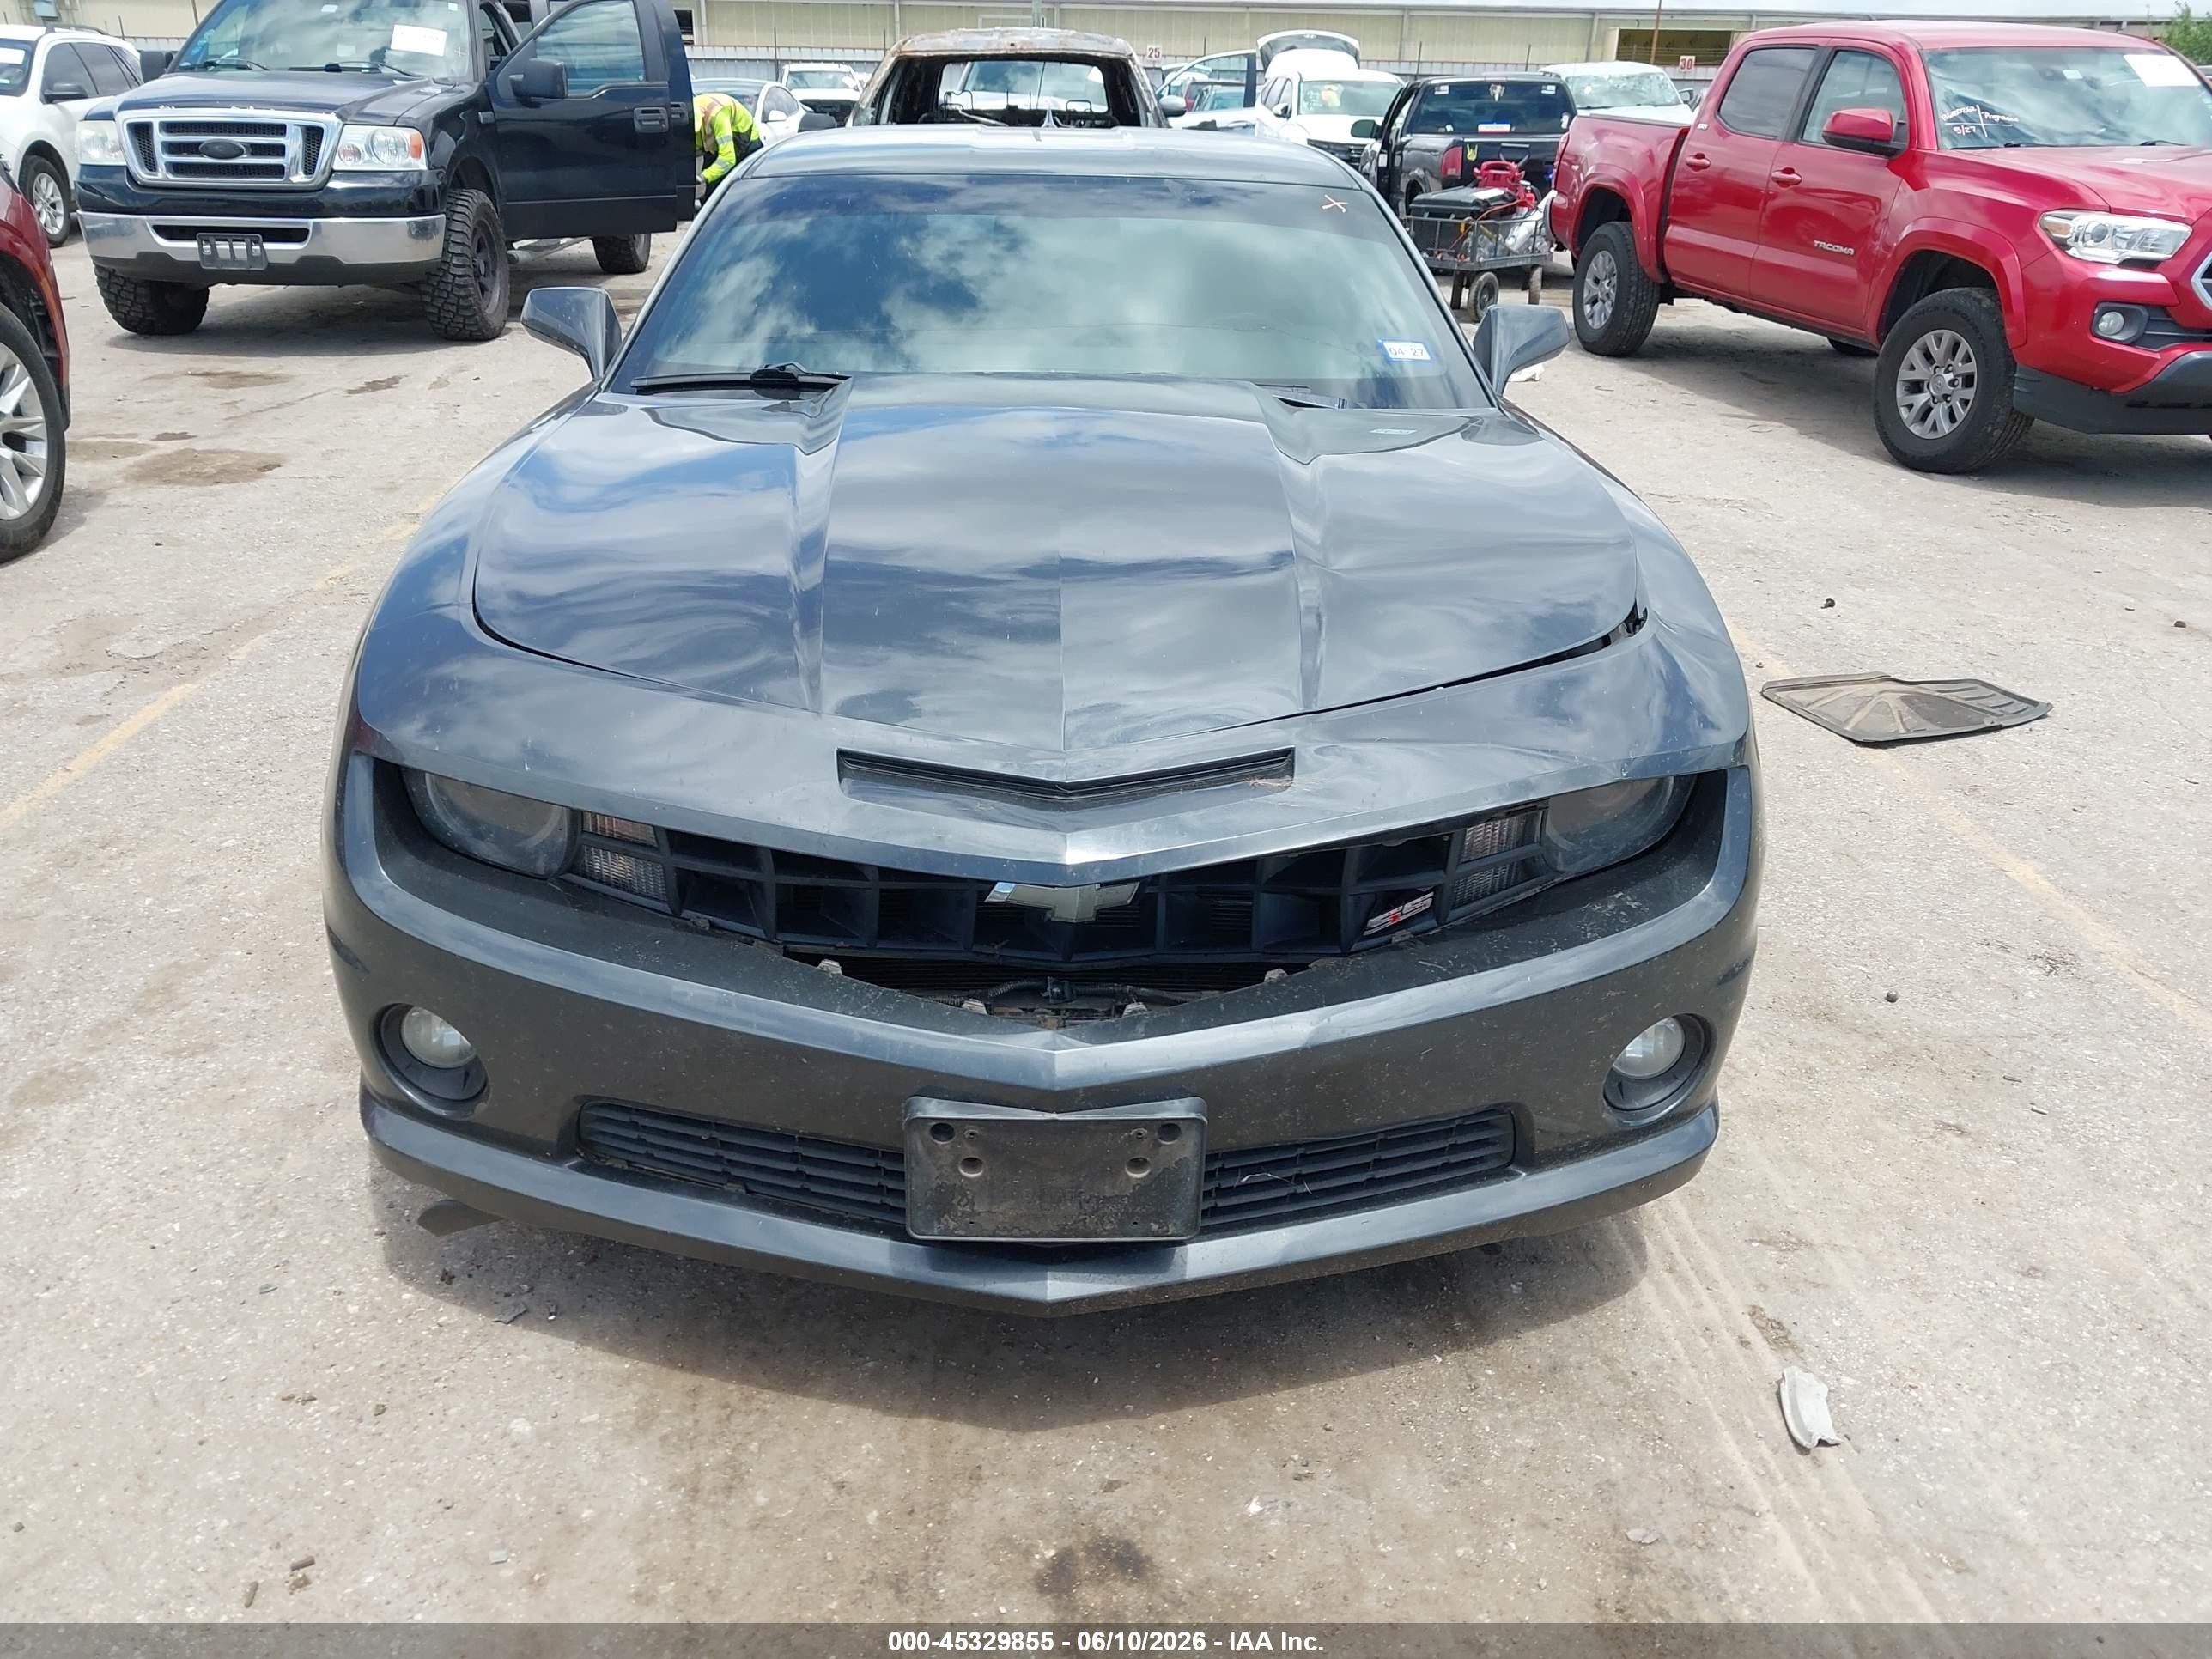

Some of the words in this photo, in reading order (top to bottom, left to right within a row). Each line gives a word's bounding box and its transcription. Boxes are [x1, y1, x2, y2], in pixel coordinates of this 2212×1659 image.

[1148, 47, 1161, 58] 25
[1680, 58, 1692, 70] 30
[1813, 240, 1855, 255] TACOMA
[1410, 347, 1425, 357] 27
